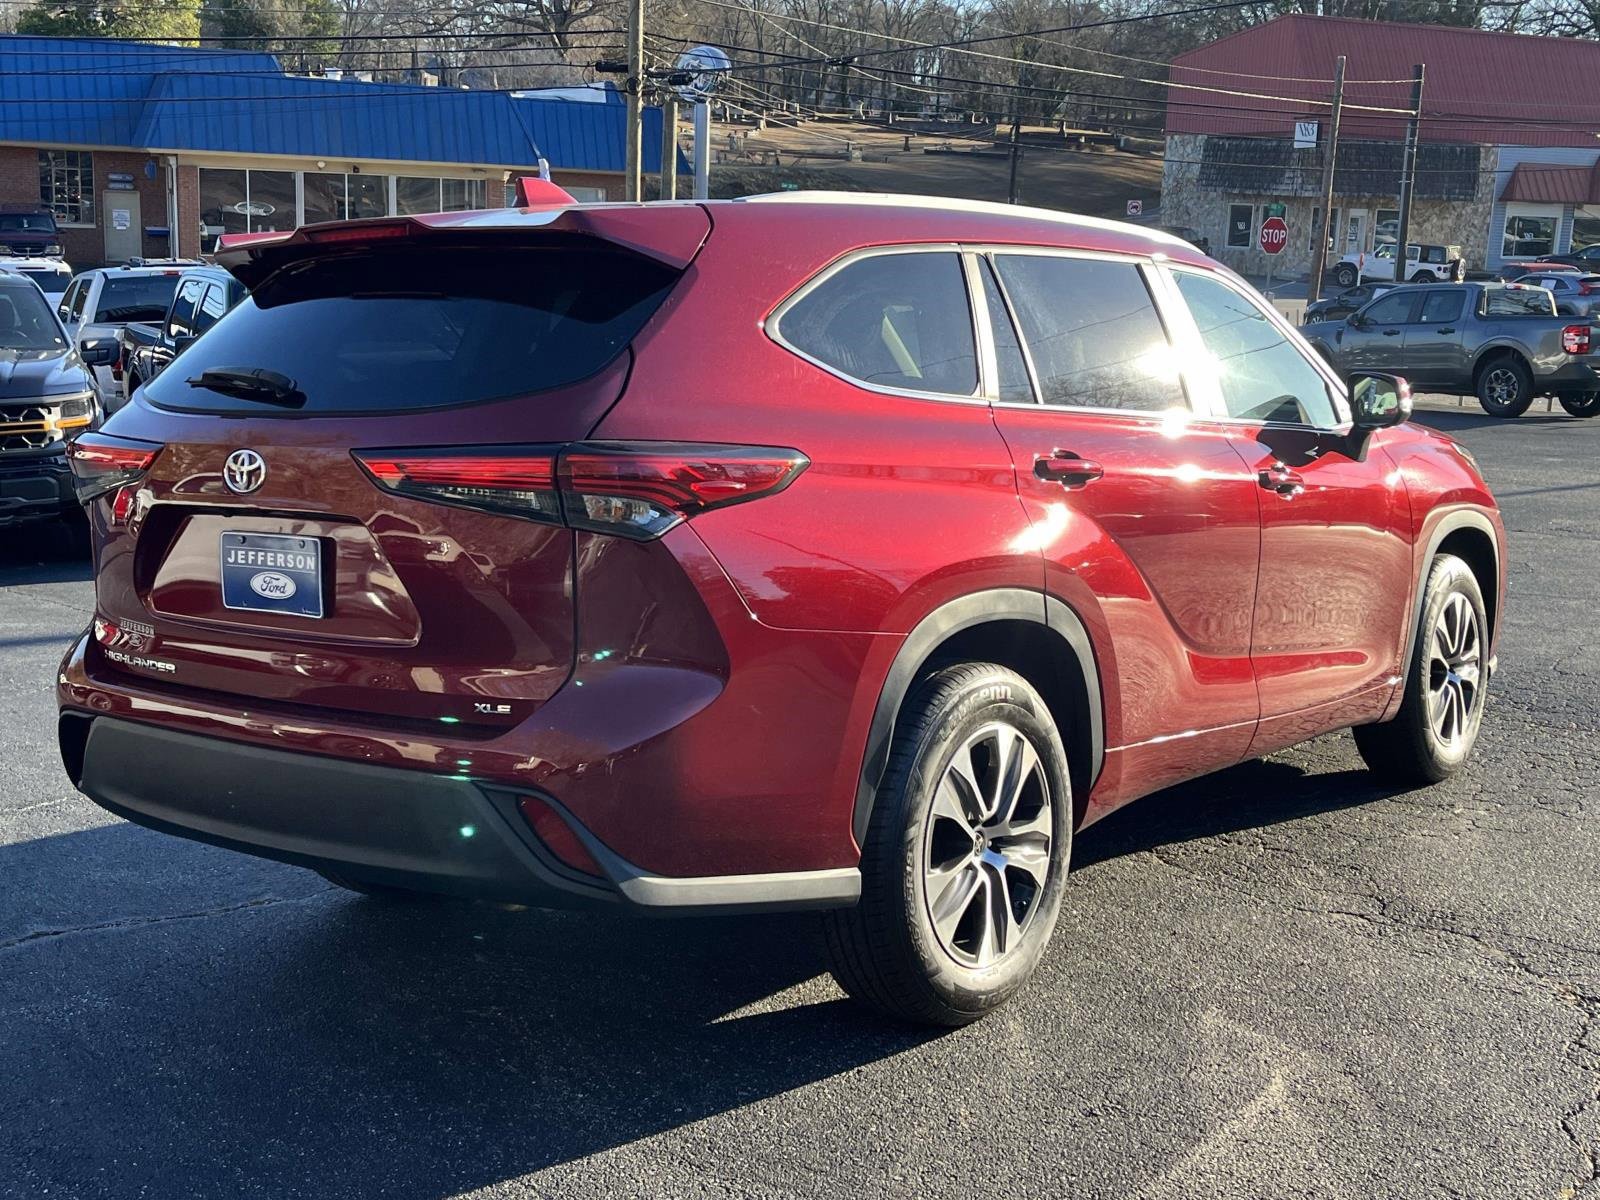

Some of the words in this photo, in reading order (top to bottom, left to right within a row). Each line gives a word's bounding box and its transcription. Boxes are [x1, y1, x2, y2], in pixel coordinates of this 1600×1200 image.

[1261, 229, 1286, 243] STOP
[227, 550, 315, 570] JEFFERSON
[260, 576, 287, 594] Ford
[120, 620, 155, 636] JEFFERSON
[104, 649, 176, 674] HIGHLANDER
[473, 702, 512, 714] XLE
